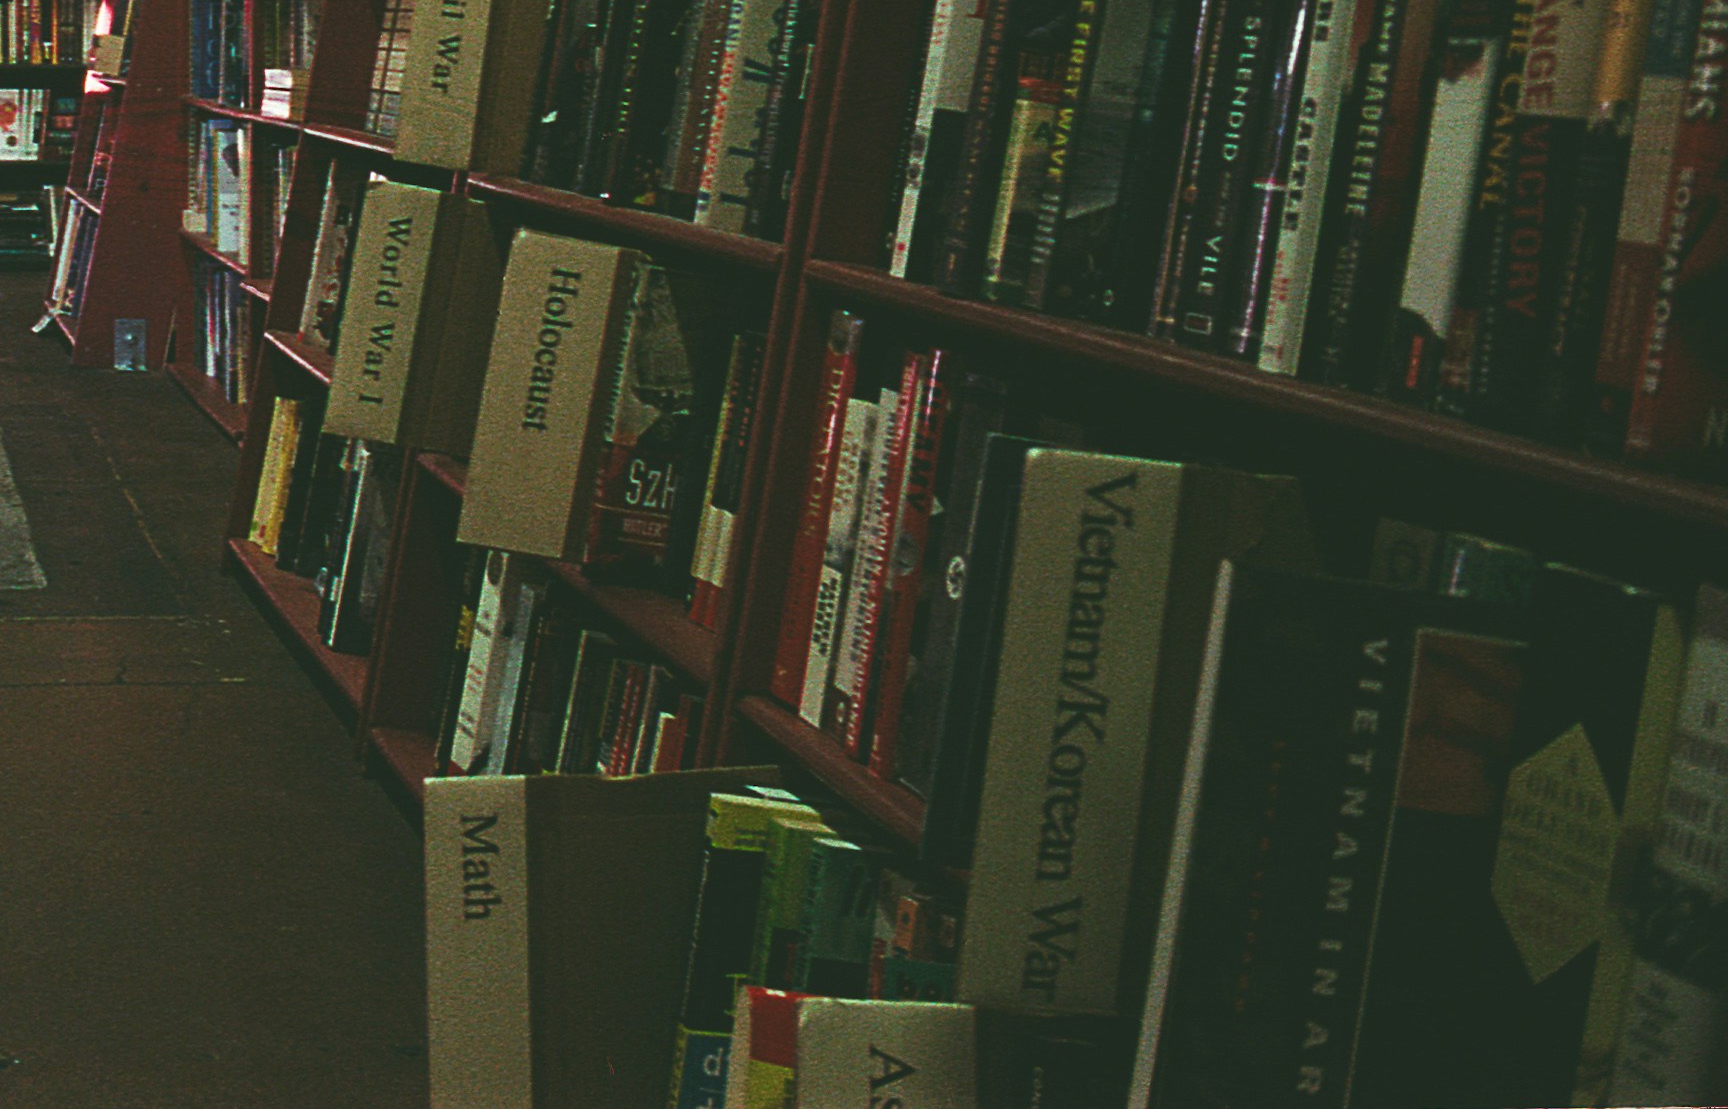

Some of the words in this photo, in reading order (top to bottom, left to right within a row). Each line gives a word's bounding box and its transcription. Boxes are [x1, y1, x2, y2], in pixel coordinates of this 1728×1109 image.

[430, 34, 461, 94] War
[1063, 21, 1090, 100] FIRST
[1221, 15, 1262, 163] SPLENDID
[1046, 106, 1075, 184] WAVE
[1283, 98, 1317, 230] CASTLE
[1345, 61, 1391, 217] MADELEINE
[1479, 72, 1519, 211] CANAL
[374, 217, 413, 307] World
[1197, 233, 1224, 296] VILE
[1504, 122, 1552, 318] VICTORY
[359, 393, 384, 405] I
[365, 320, 396, 382] War
[521, 267, 581, 433] Holocaust
[1035, 472, 1139, 881] Vietnam/Korean
[1324, 637, 1389, 914] VIETNAM
[460, 813, 503, 922] Math
[1020, 897, 1082, 1002] War
[1311, 937, 1342, 997] IN
